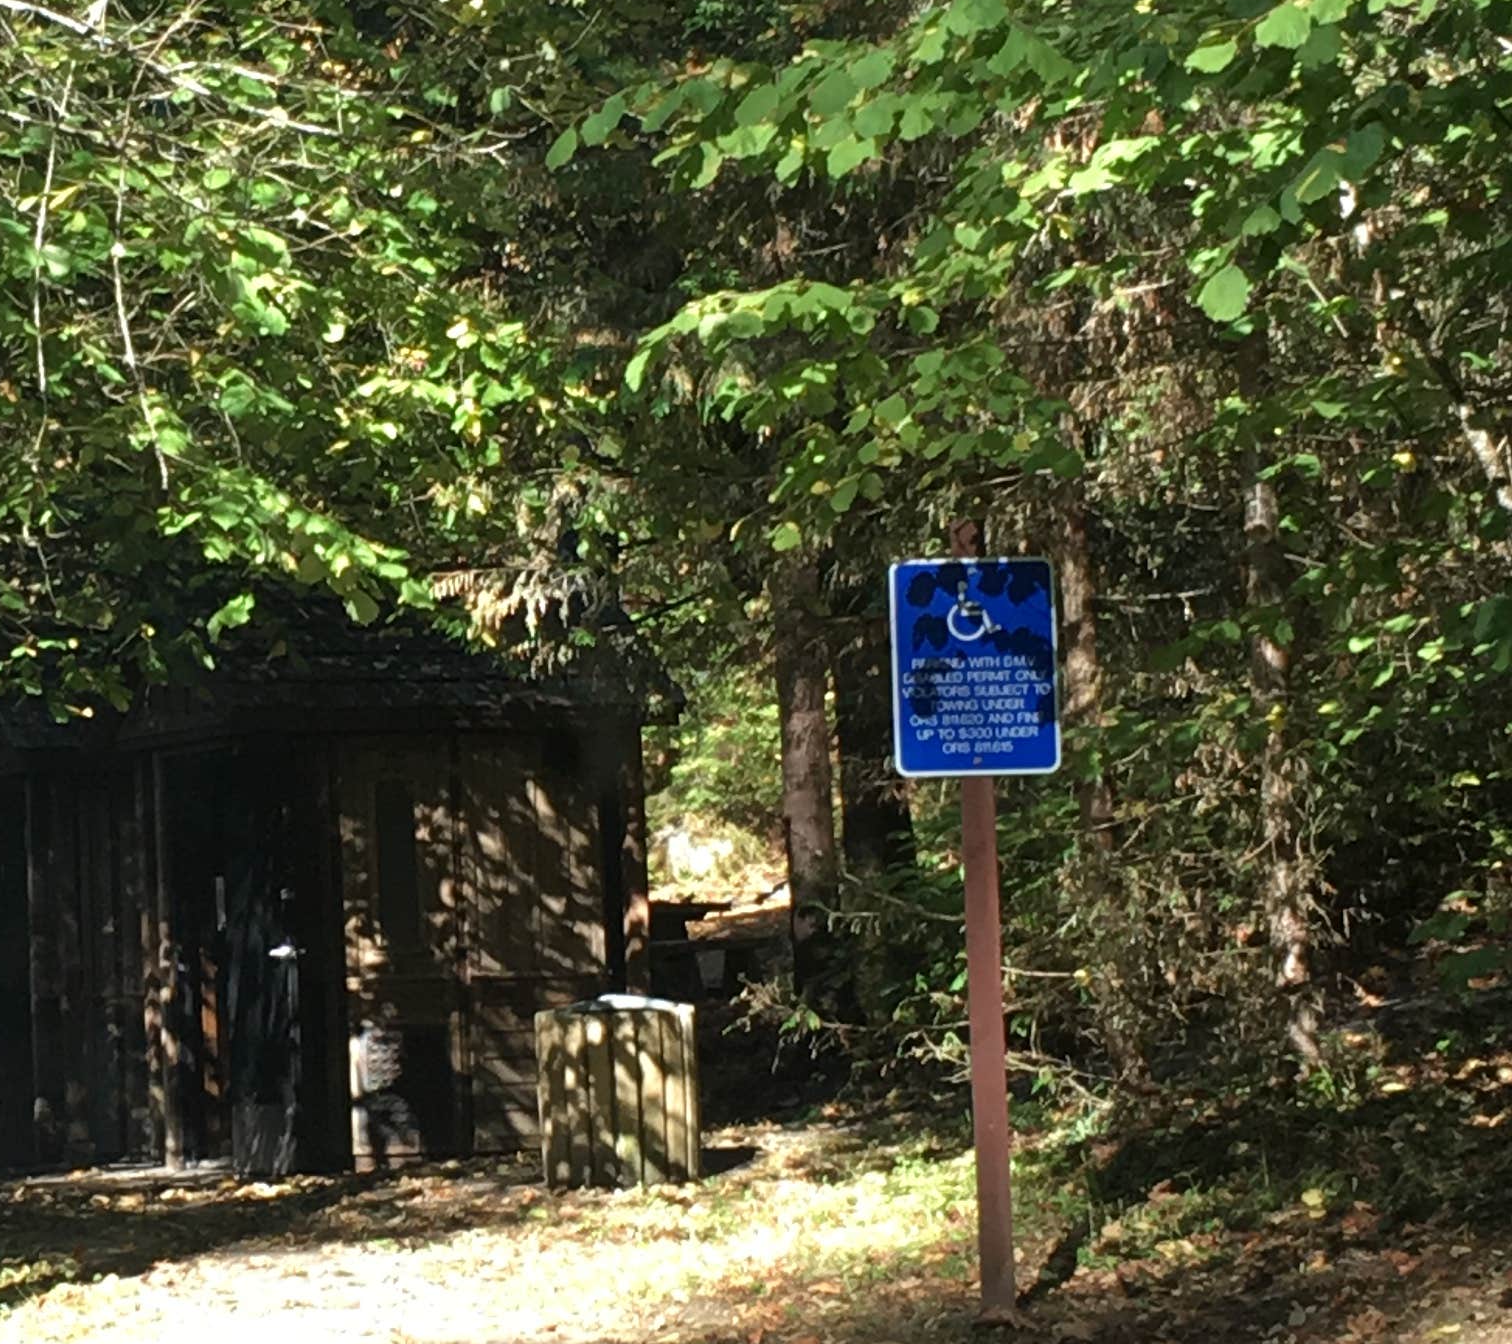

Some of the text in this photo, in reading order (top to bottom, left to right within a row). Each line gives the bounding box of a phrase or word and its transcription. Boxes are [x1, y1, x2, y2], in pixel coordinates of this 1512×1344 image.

[911, 657, 965, 669] PAING
[968, 656, 1000, 668] WITH
[902, 669, 1047, 684] DIBLED PERMIT ONLY
[974, 683, 1029, 696] SUBJECT
[1033, 682, 1051, 695] TO
[981, 698, 1025, 711] UNDER
[988, 712, 1014, 724] AND
[915, 728, 935, 740] UP
[937, 727, 955, 740] TO
[994, 725, 1039, 738] UNDER
